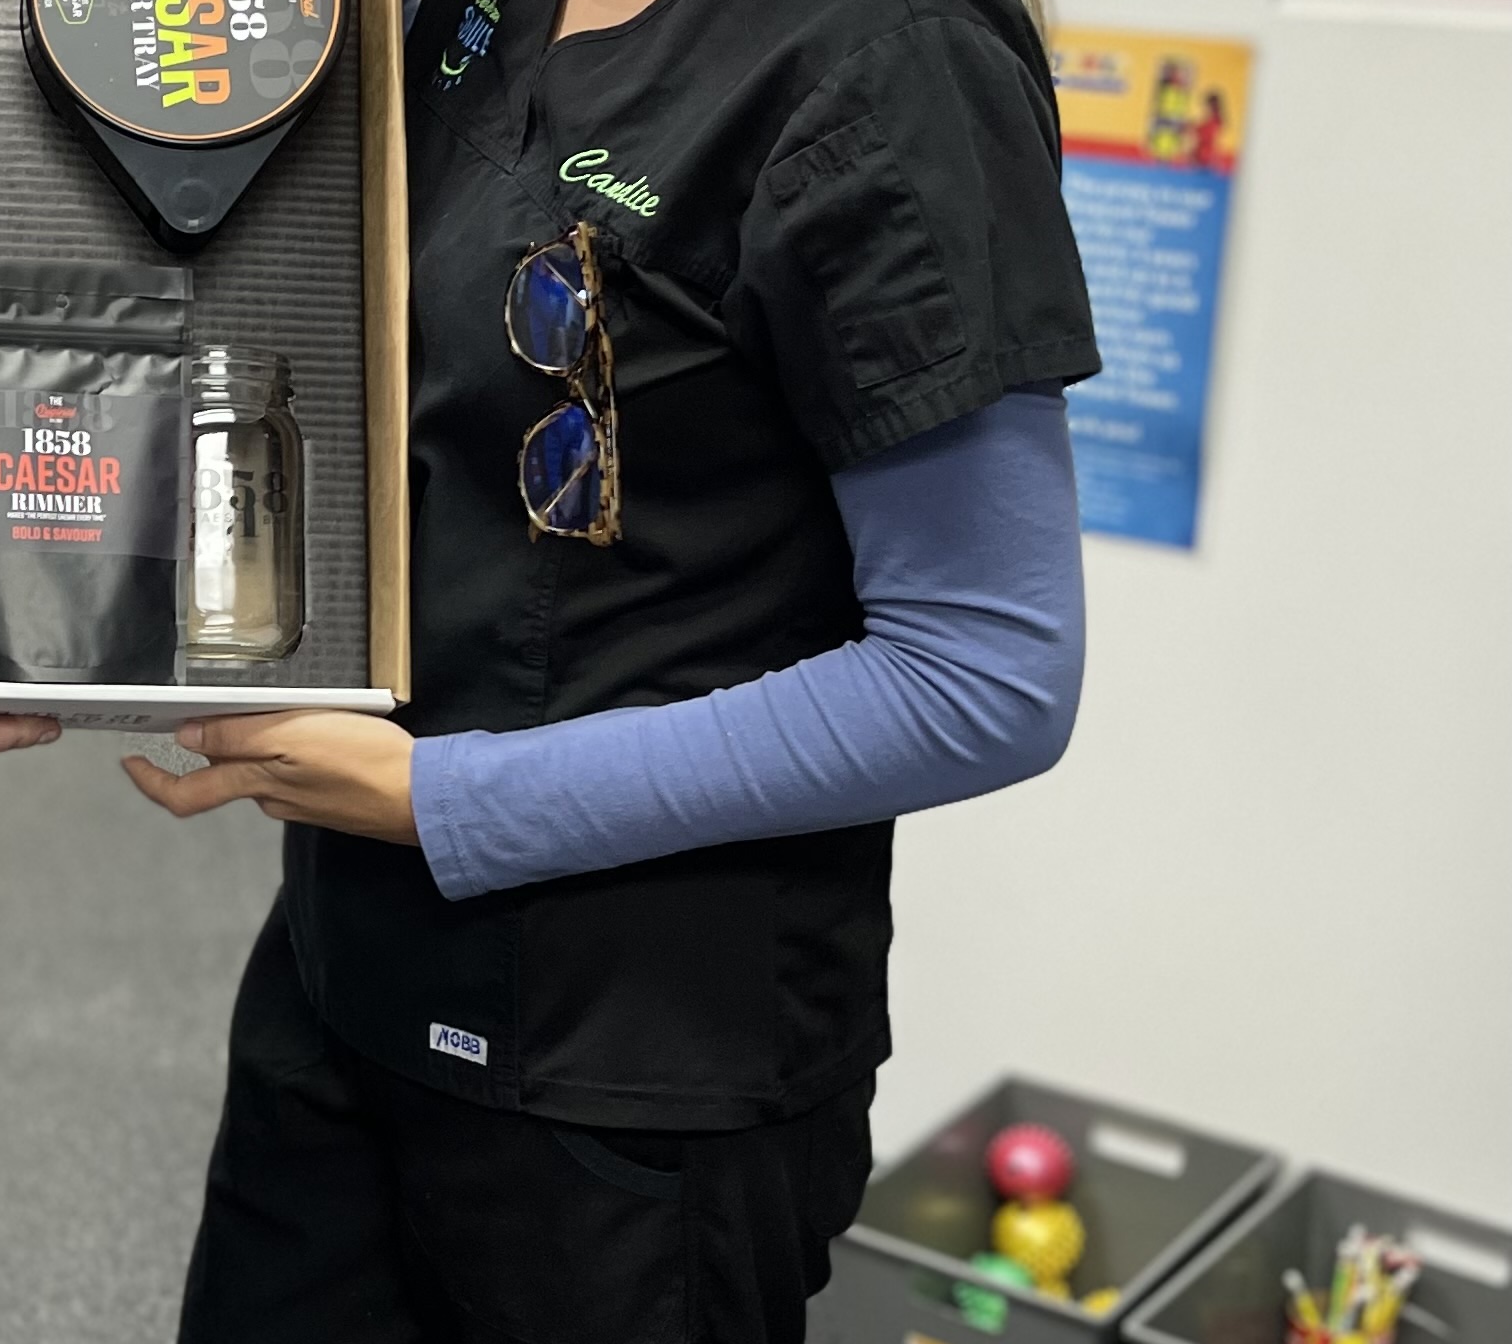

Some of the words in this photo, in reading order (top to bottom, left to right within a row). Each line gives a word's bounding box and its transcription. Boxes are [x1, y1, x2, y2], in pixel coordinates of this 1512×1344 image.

[132, 16, 160, 91] TRAY
[49, 395, 64, 407] THE
[21, 428, 92, 456] 1858
[11, 492, 102, 514] RIMMER
[193, 469, 287, 514] 858
[12, 525, 40, 541] BOLD
[53, 526, 103, 542] SAVOURY
[436, 1027, 481, 1055] MOBB
